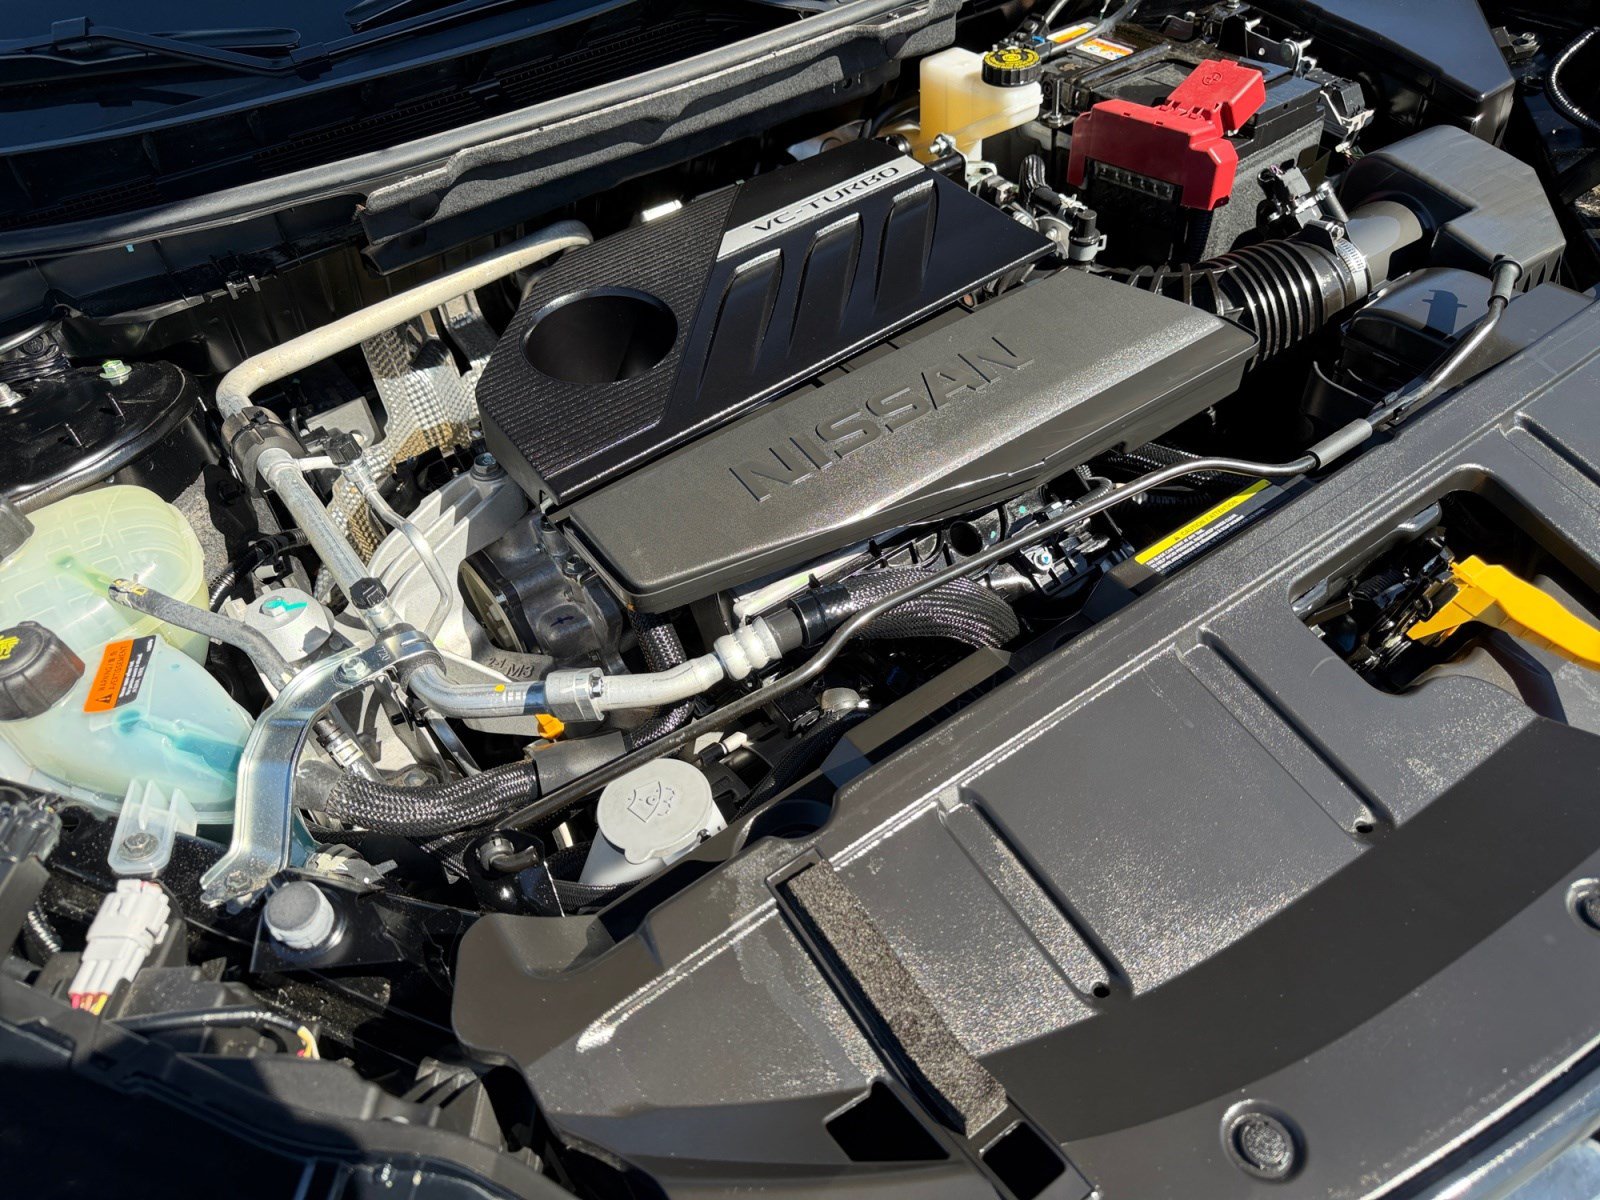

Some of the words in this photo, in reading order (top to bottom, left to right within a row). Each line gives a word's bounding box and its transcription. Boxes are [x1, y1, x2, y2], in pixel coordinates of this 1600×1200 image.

[752, 166, 899, 232] VC-TURBO
[729, 336, 1034, 502] NISSAN
[1180, 517, 1206, 536] CAUTION
[1209, 500, 1238, 517] ATTENTION
